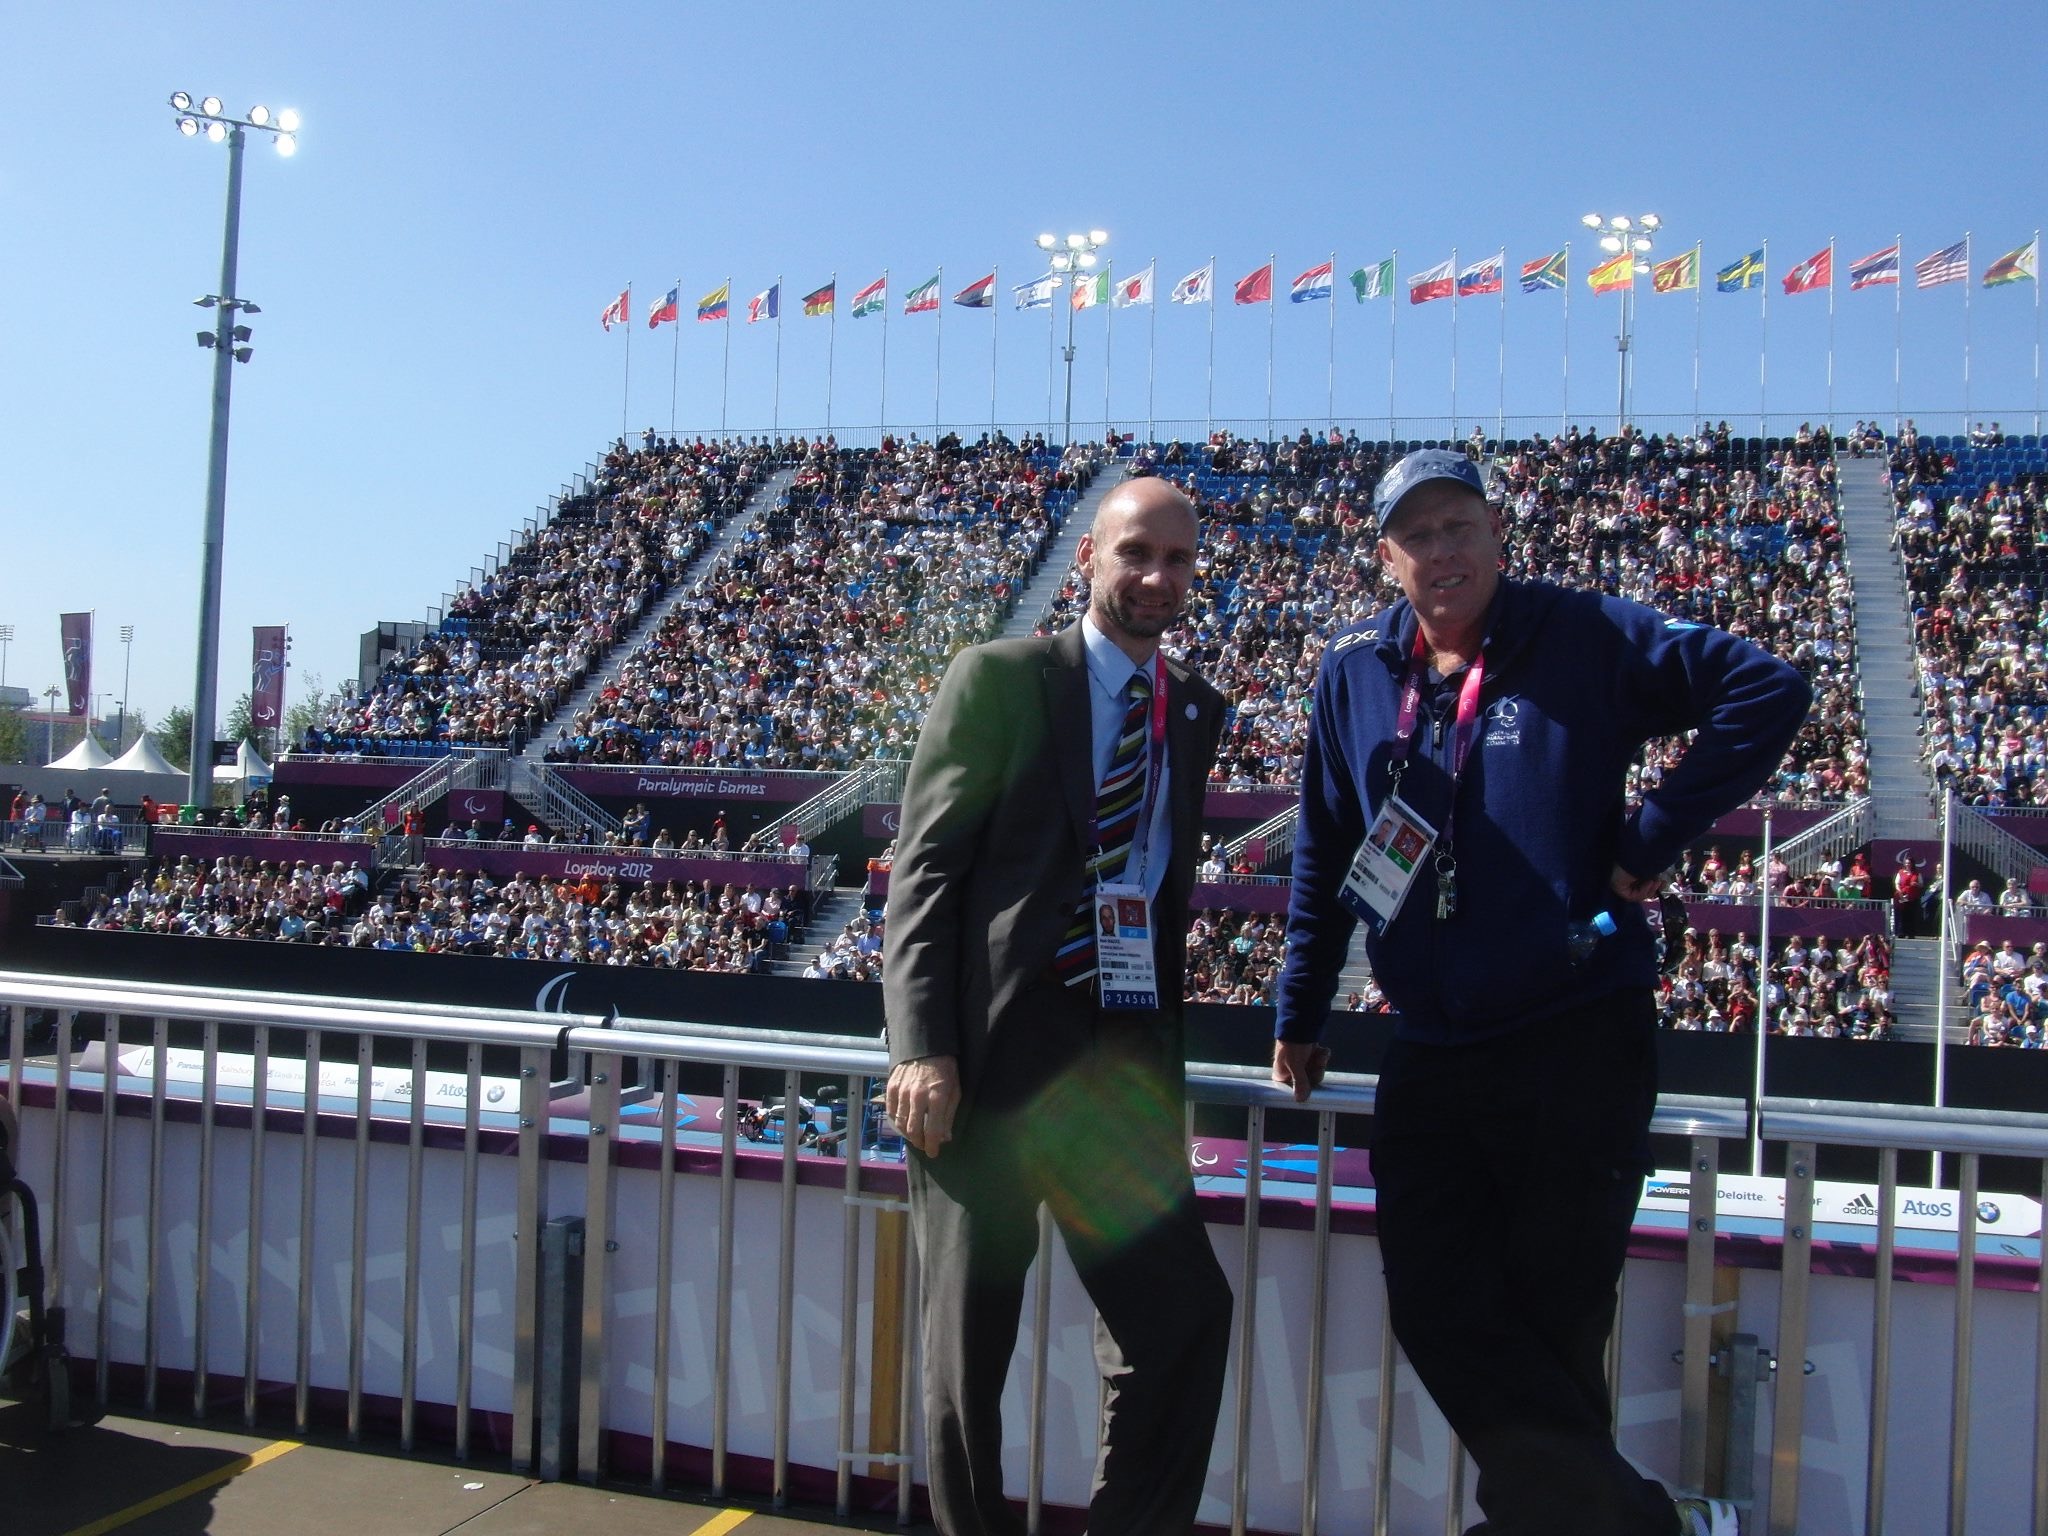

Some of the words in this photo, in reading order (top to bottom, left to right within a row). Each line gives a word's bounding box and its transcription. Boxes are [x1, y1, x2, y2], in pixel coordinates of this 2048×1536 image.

[1404, 689, 1417, 713] London
[637, 777, 715, 797] Paralympic
[718, 779, 767, 796] Games
[563, 859, 616, 877] London
[619, 862, 654, 879] 2012
